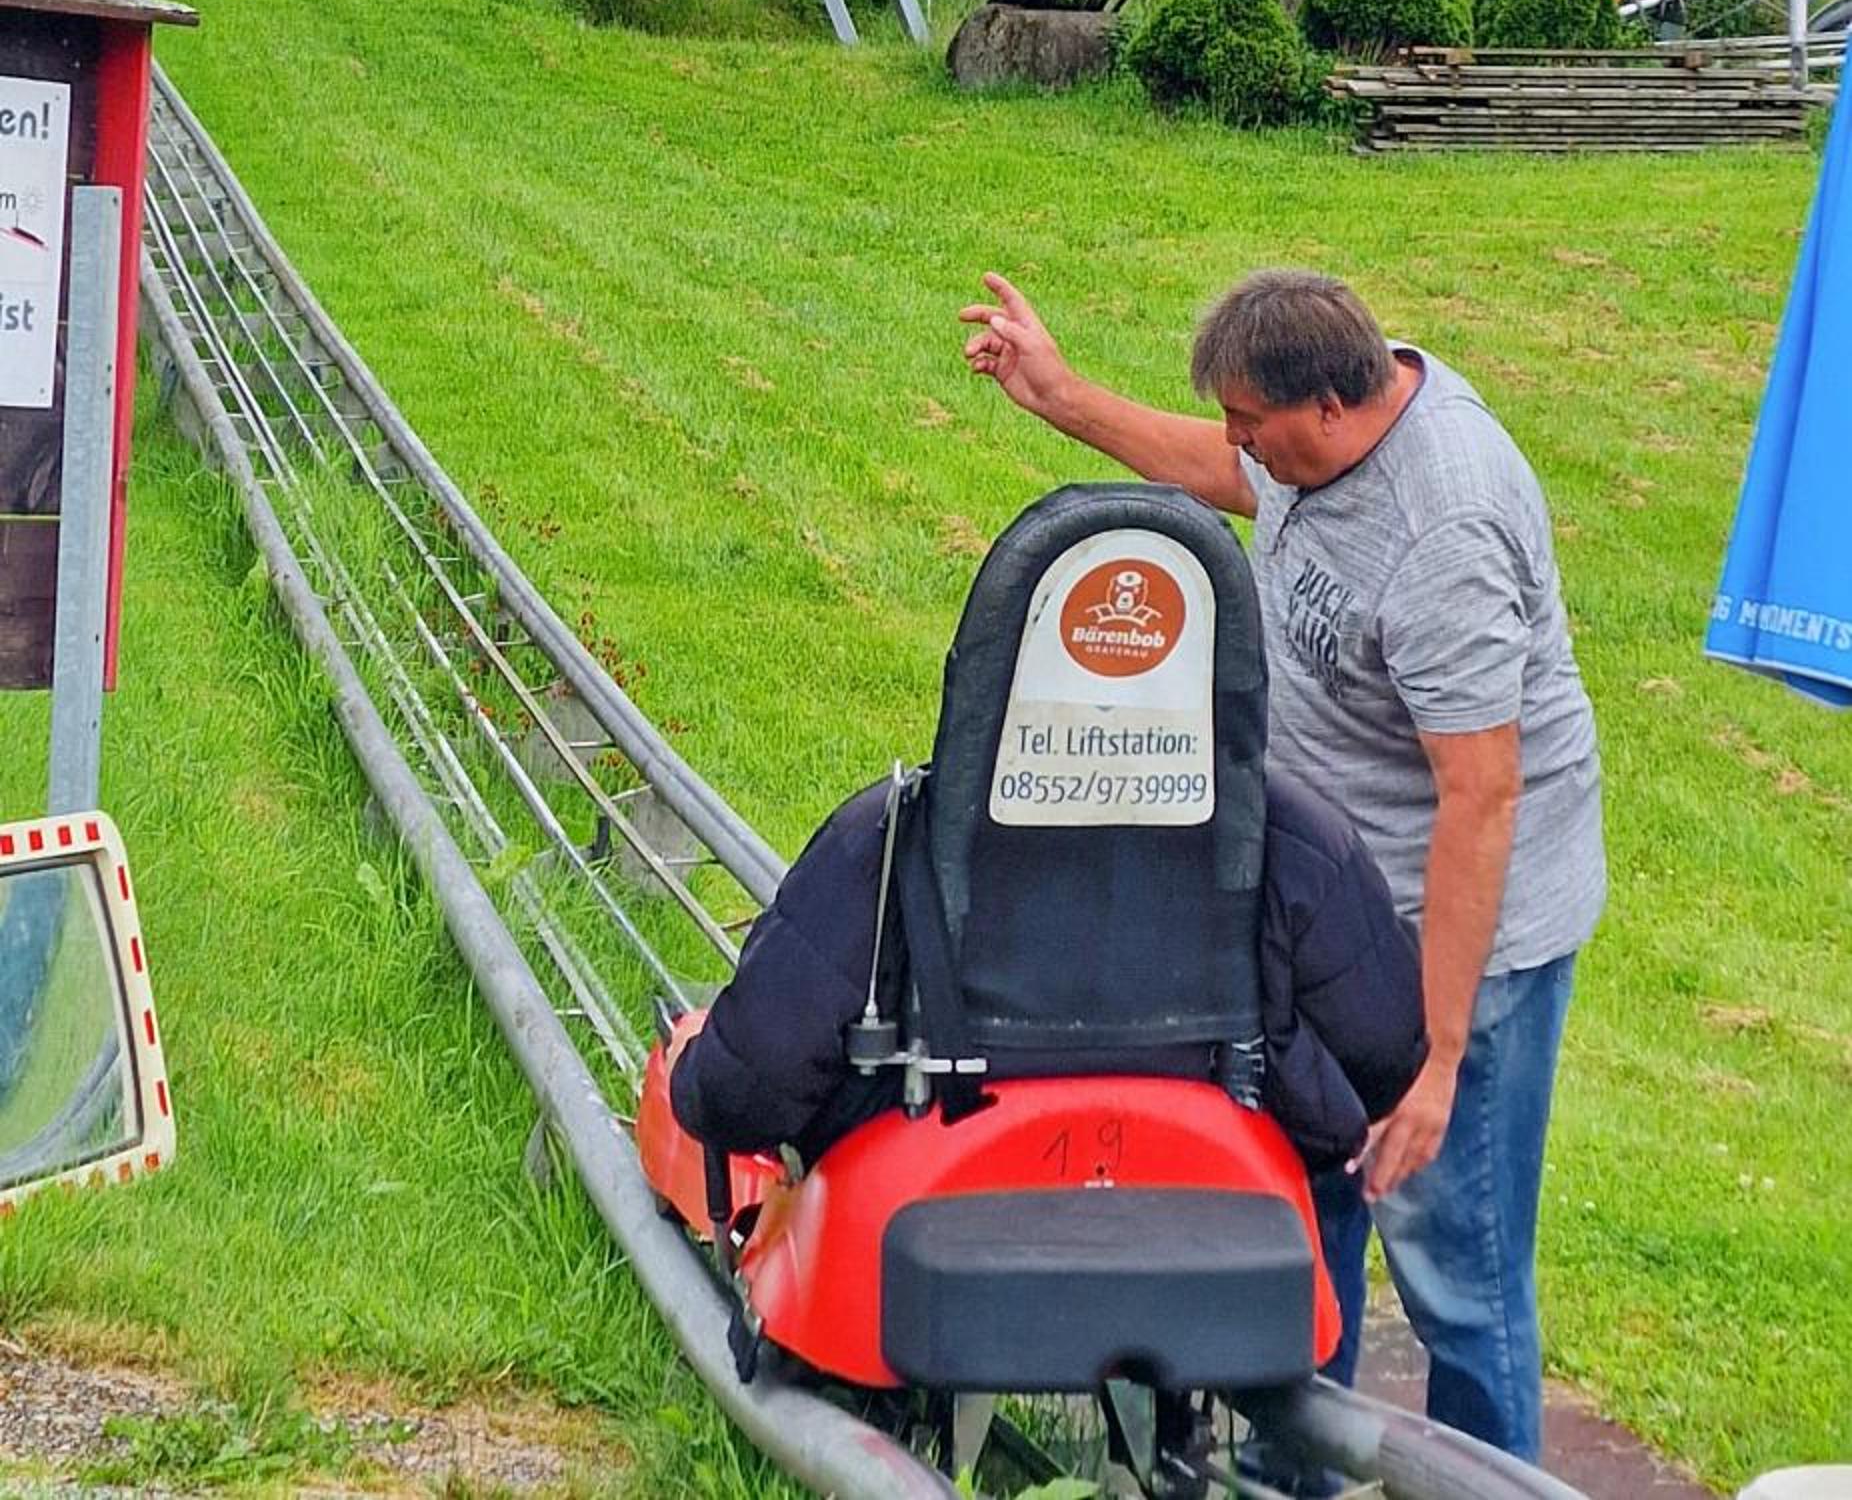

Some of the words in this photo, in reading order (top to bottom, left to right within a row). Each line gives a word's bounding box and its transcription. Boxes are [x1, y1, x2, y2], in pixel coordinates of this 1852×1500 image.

[1071, 624, 1166, 649] Bärenbob
[1017, 723, 1058, 755] Tel.
[1066, 724, 1198, 757] Liftstation:
[1000, 770, 1208, 805] 08552/9739999
